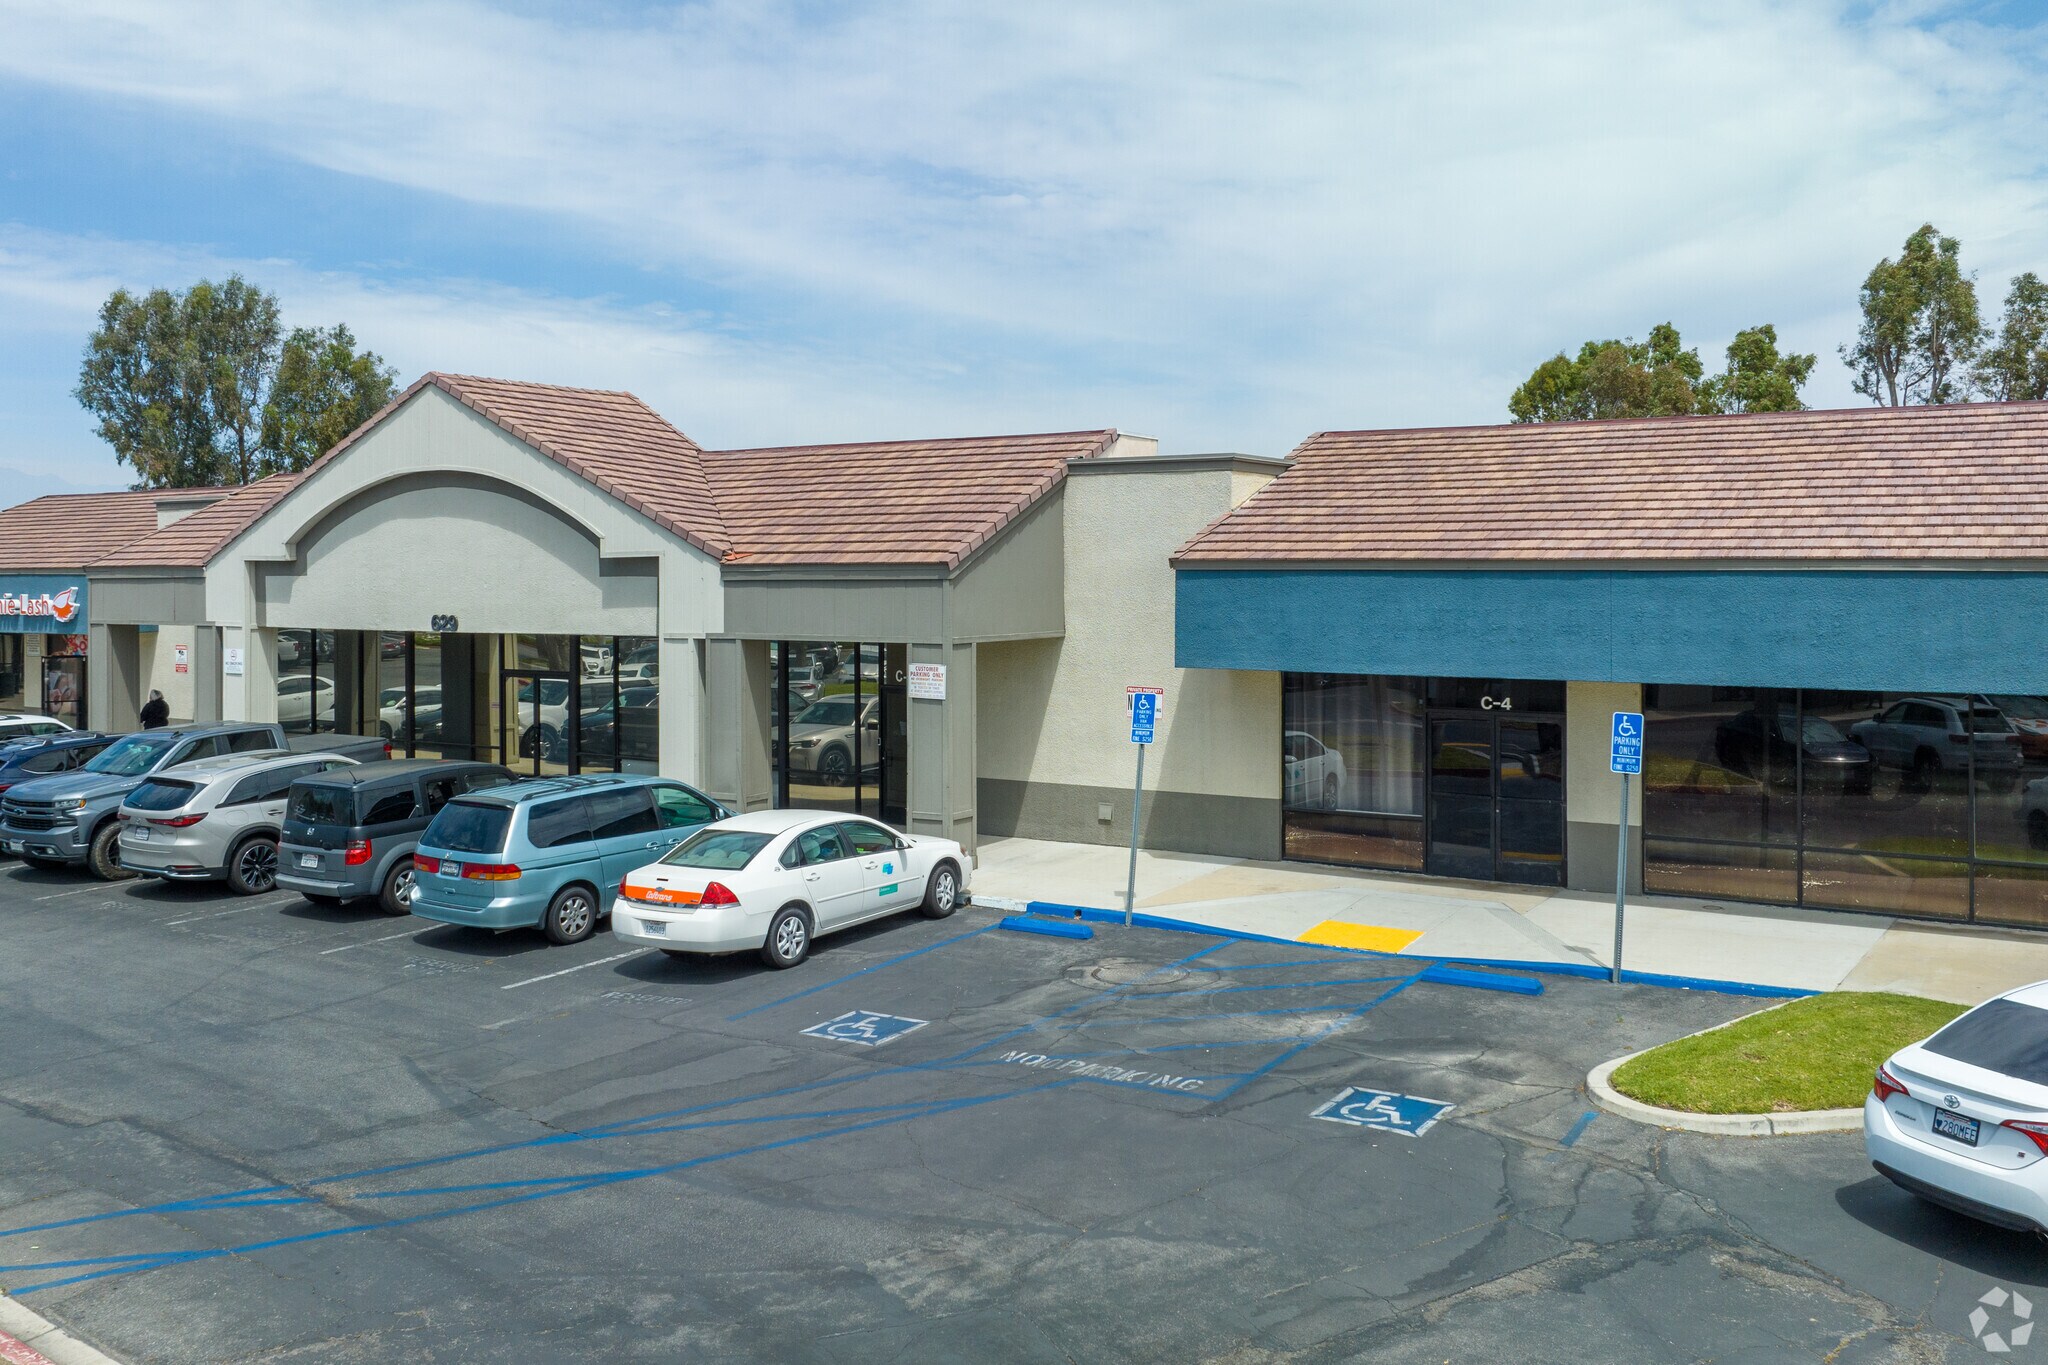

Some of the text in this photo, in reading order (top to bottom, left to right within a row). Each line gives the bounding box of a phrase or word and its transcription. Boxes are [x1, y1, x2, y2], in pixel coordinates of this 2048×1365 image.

[20, 594, 49, 615] Lash
[1480, 696, 1512, 711] C-4
[1614, 736, 1640, 746] PARKING
[1618, 745, 1635, 756] ONLY
[1616, 757, 1636, 765] MINIMUM
[1613, 763, 1639, 772] FINE $250
[646, 890, 673, 901] Caltrans
[1000, 1050, 1204, 1092] NO PARKING
[1942, 1120, 1977, 1142] 280MEE
